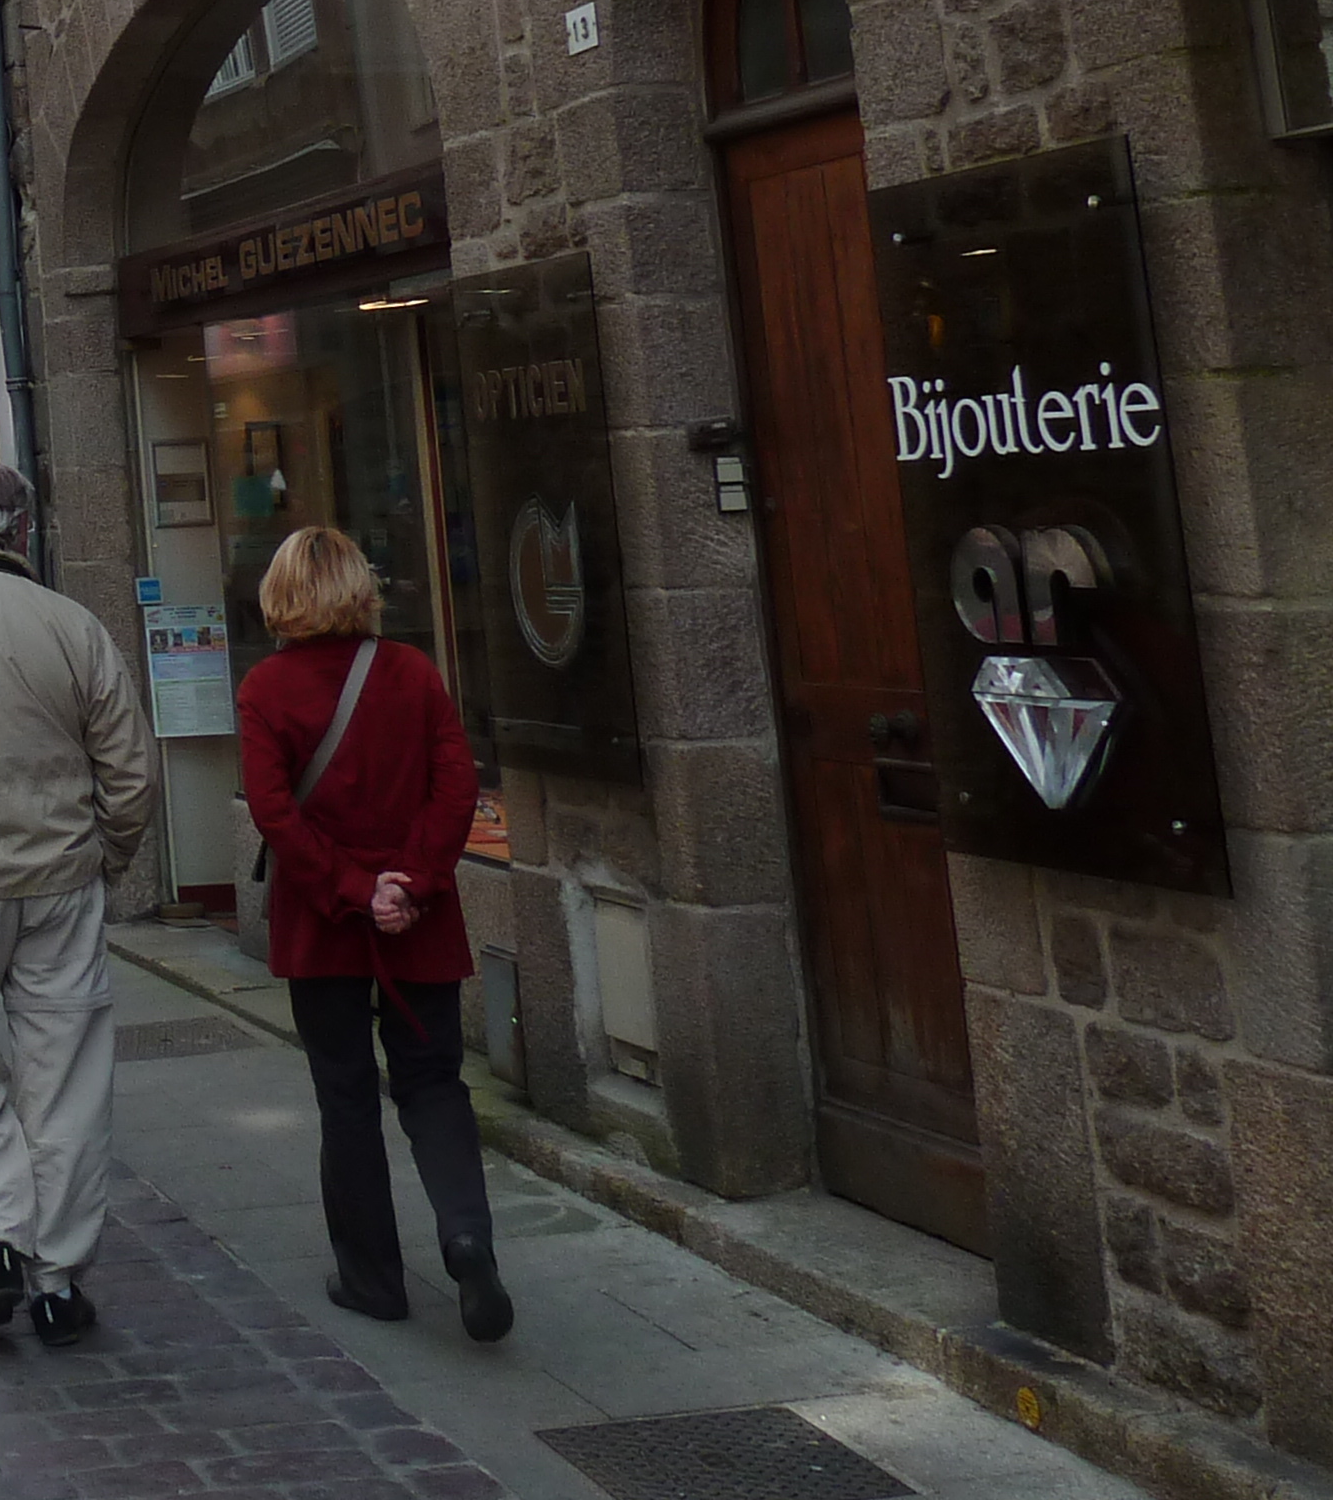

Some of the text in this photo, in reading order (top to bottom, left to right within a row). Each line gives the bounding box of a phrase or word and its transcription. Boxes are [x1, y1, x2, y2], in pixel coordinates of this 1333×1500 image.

[572, 17, 591, 43] 13
[151, 191, 424, 301] MICHEL GUEZENNEC
[476, 358, 587, 421] OPTICIEN
[887, 361, 1162, 479] Bijouterie
